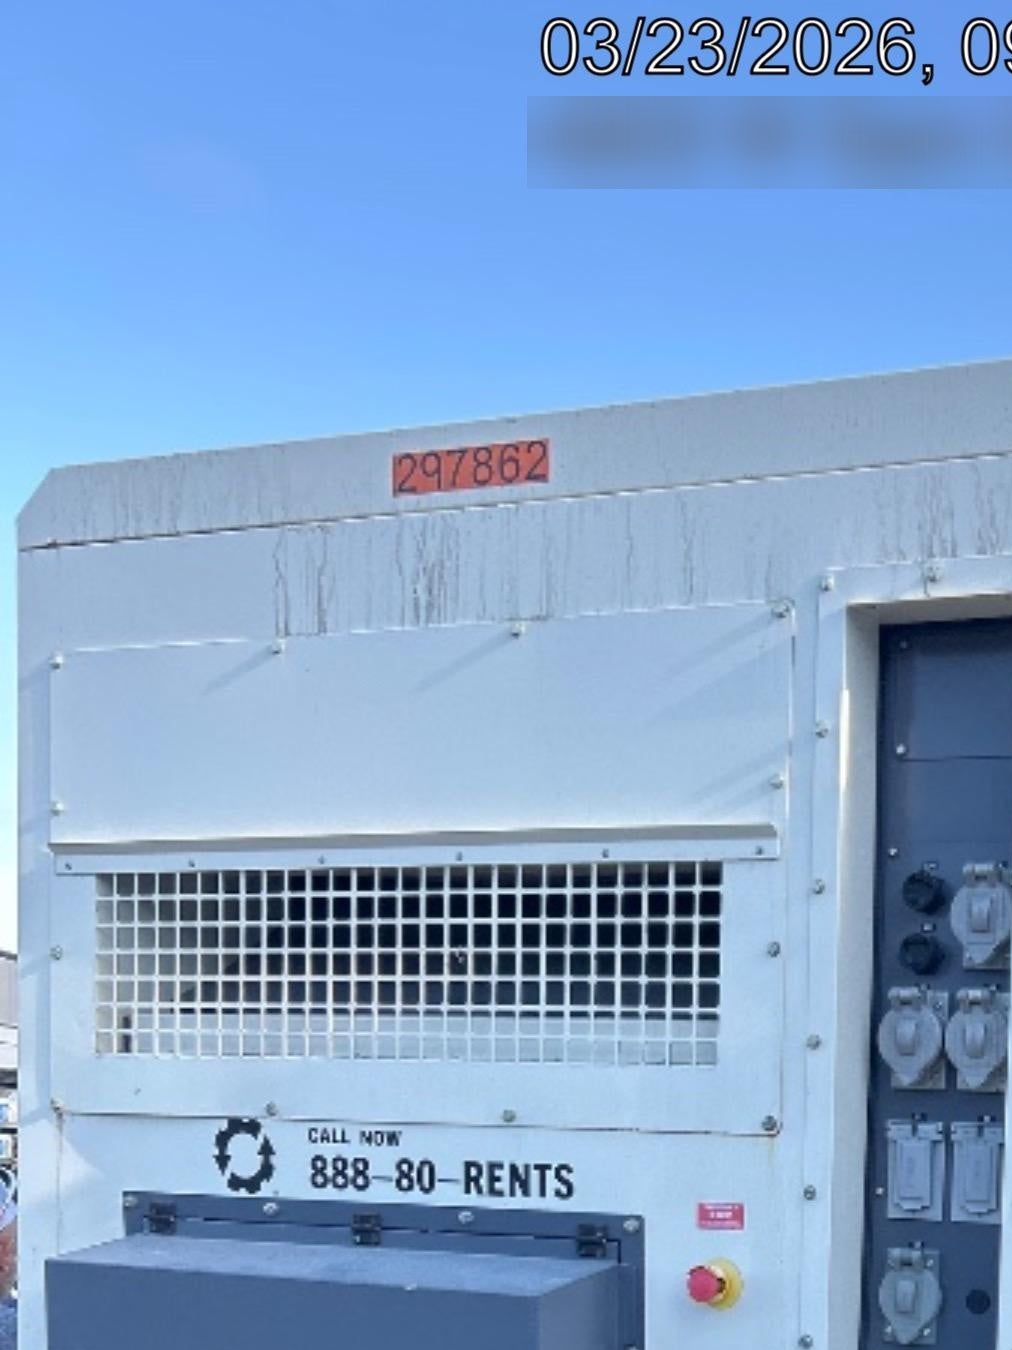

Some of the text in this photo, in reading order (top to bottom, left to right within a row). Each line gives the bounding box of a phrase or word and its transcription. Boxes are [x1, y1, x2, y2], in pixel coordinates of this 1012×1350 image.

[397, 440, 547, 492] 297862
[308, 1127, 403, 1147] CALL NOW
[310, 1154, 575, 1200] 888-80-RENTS
